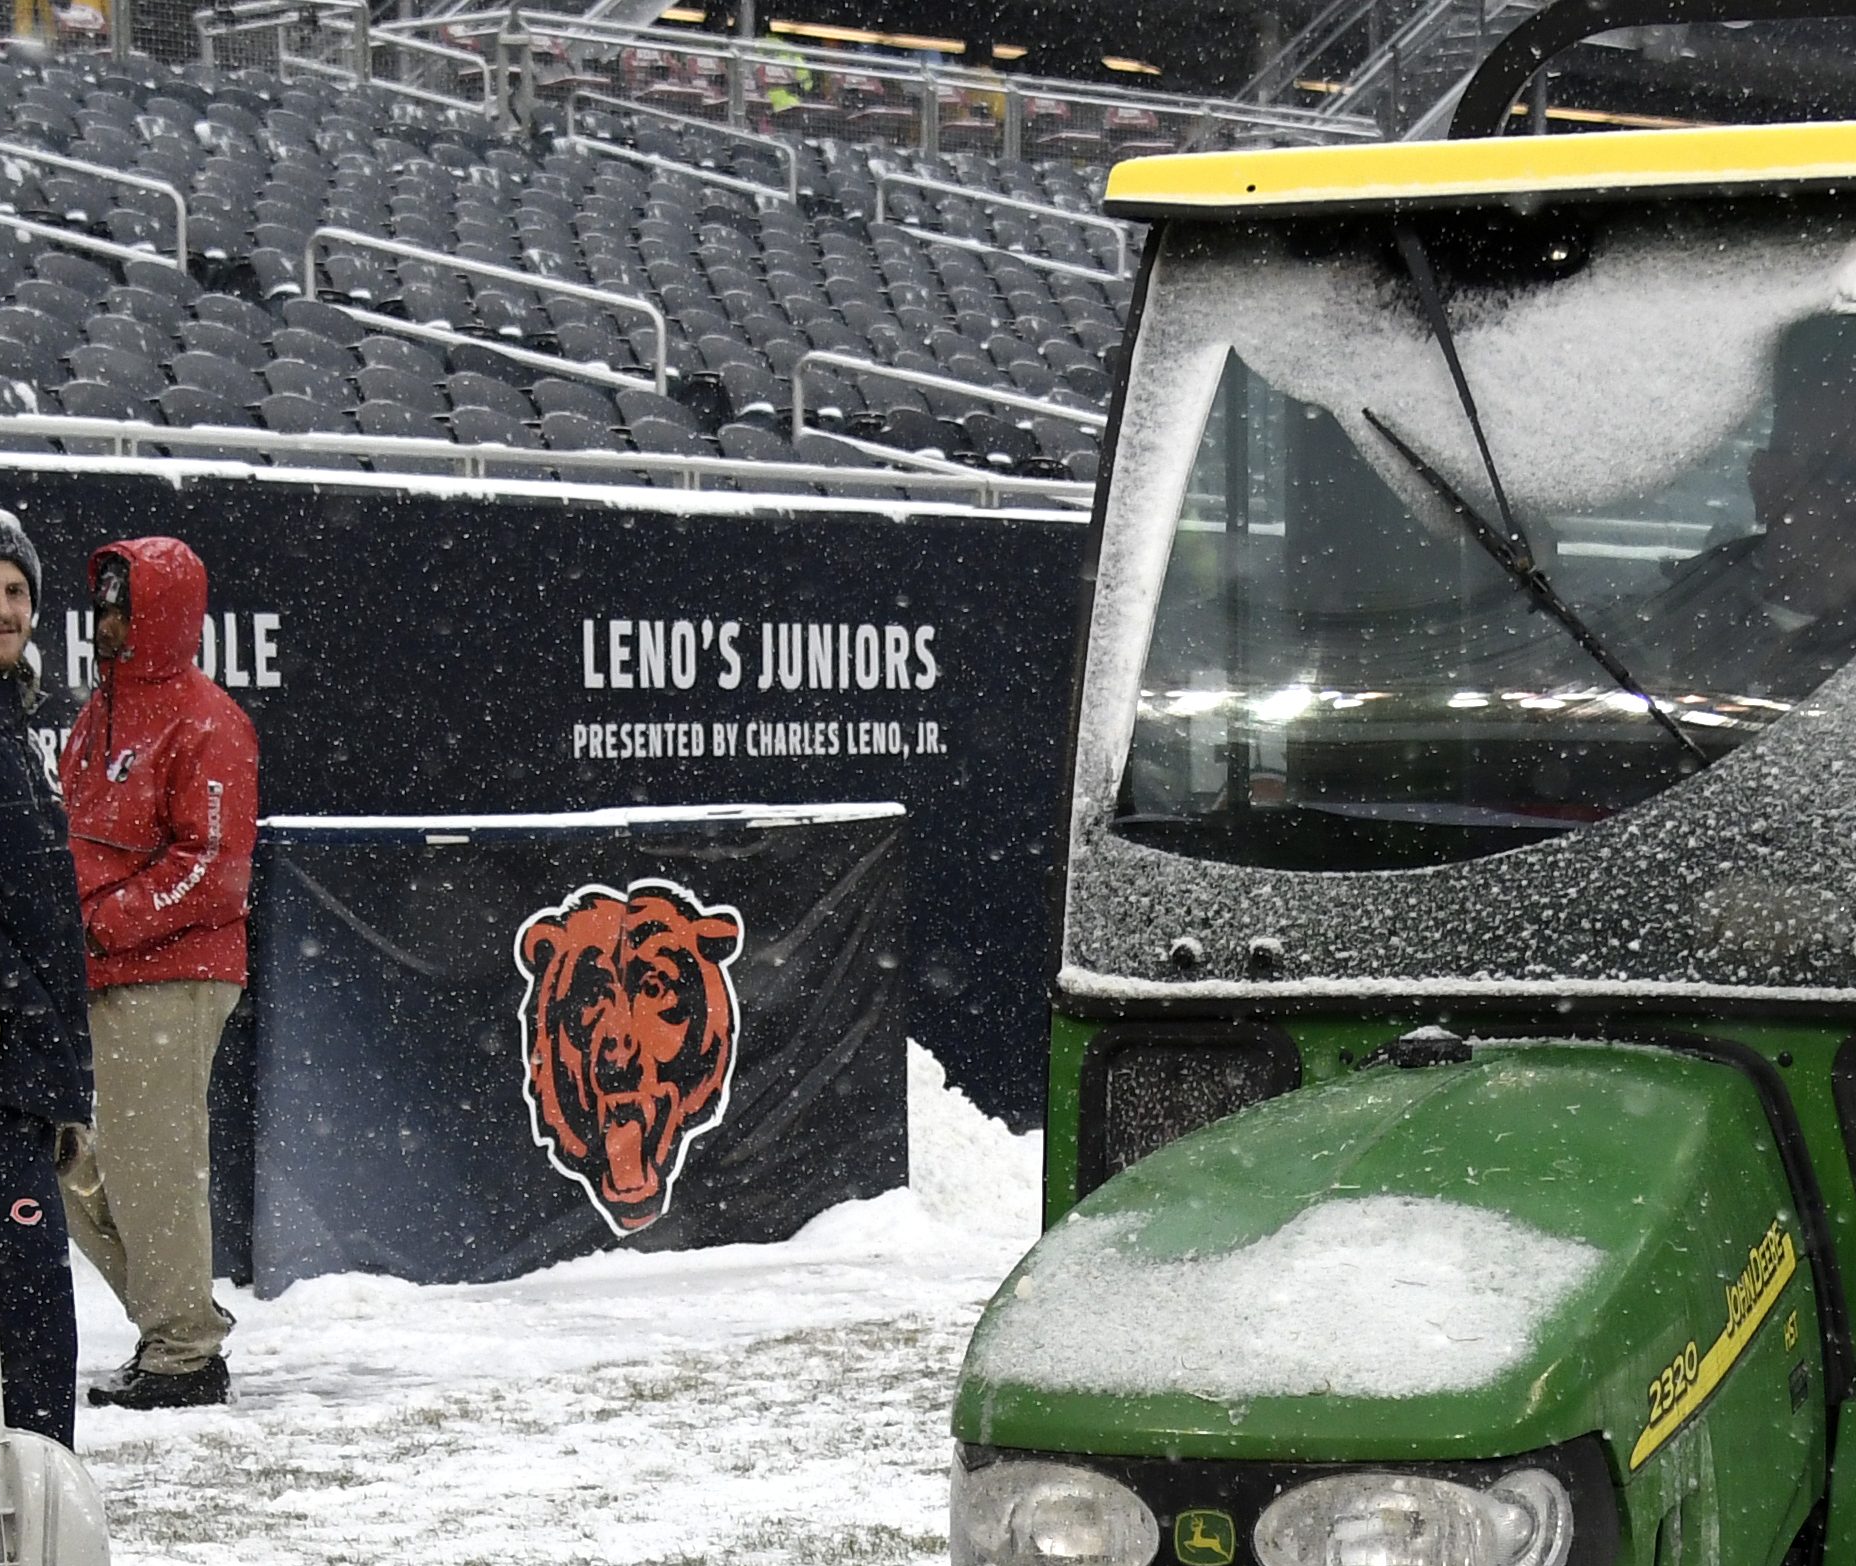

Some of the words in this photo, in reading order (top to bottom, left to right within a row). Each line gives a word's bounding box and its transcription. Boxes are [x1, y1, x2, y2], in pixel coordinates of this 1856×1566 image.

[66, 611, 282, 688] HDLE
[582, 618, 742, 690] LENO'S
[757, 622, 938, 691] JUNIORS
[573, 722, 705, 759] PRESENTED
[712, 722, 739, 757] BY
[746, 721, 840, 757] CHARLES
[846, 721, 910, 760] LENO,
[915, 721, 947, 756] JR.
[1726, 1268, 1757, 1336] JOHN
[1749, 1219, 1785, 1291] DEERE
[1649, 1341, 1698, 1424] 2320
